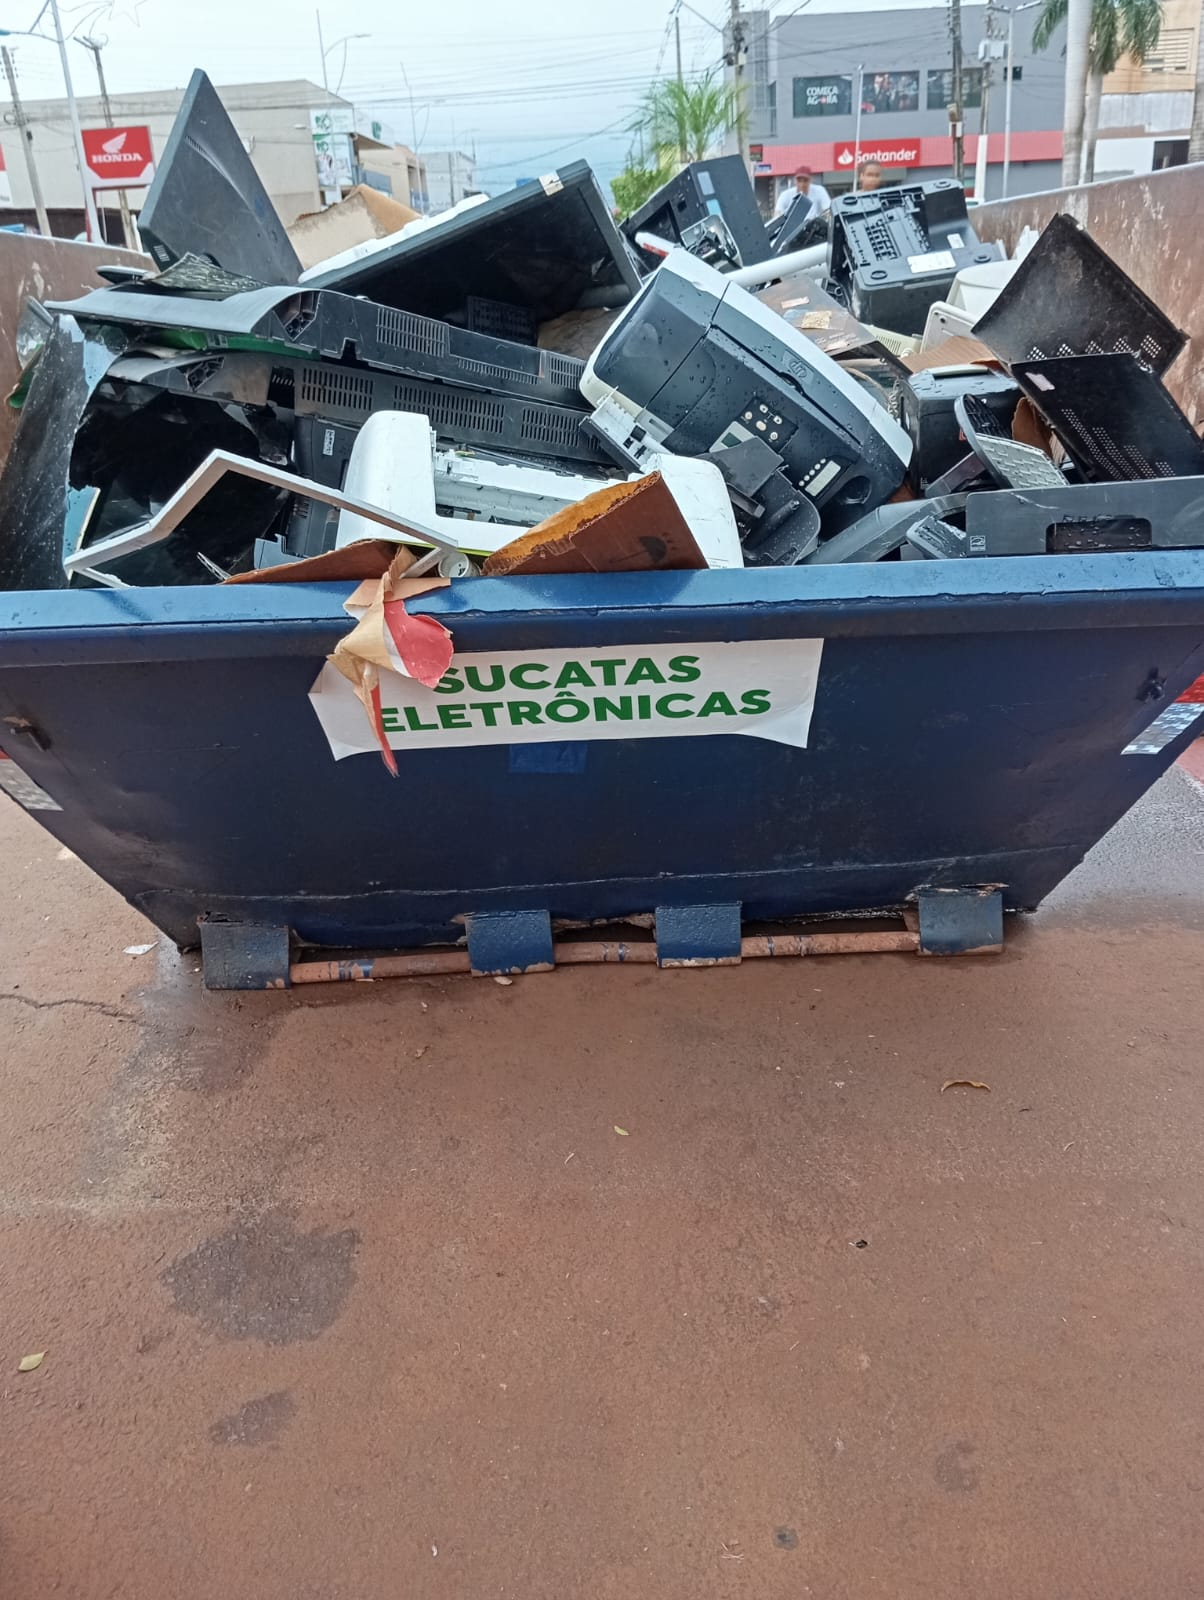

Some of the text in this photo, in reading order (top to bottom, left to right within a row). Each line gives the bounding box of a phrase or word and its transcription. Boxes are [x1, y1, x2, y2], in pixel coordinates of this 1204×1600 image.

[91, 153, 143, 163] HONDA
[857, 149, 917, 164] Santander
[433, 655, 701, 694] SUCATAS
[380, 689, 771, 732] ELETRÔNICAS
